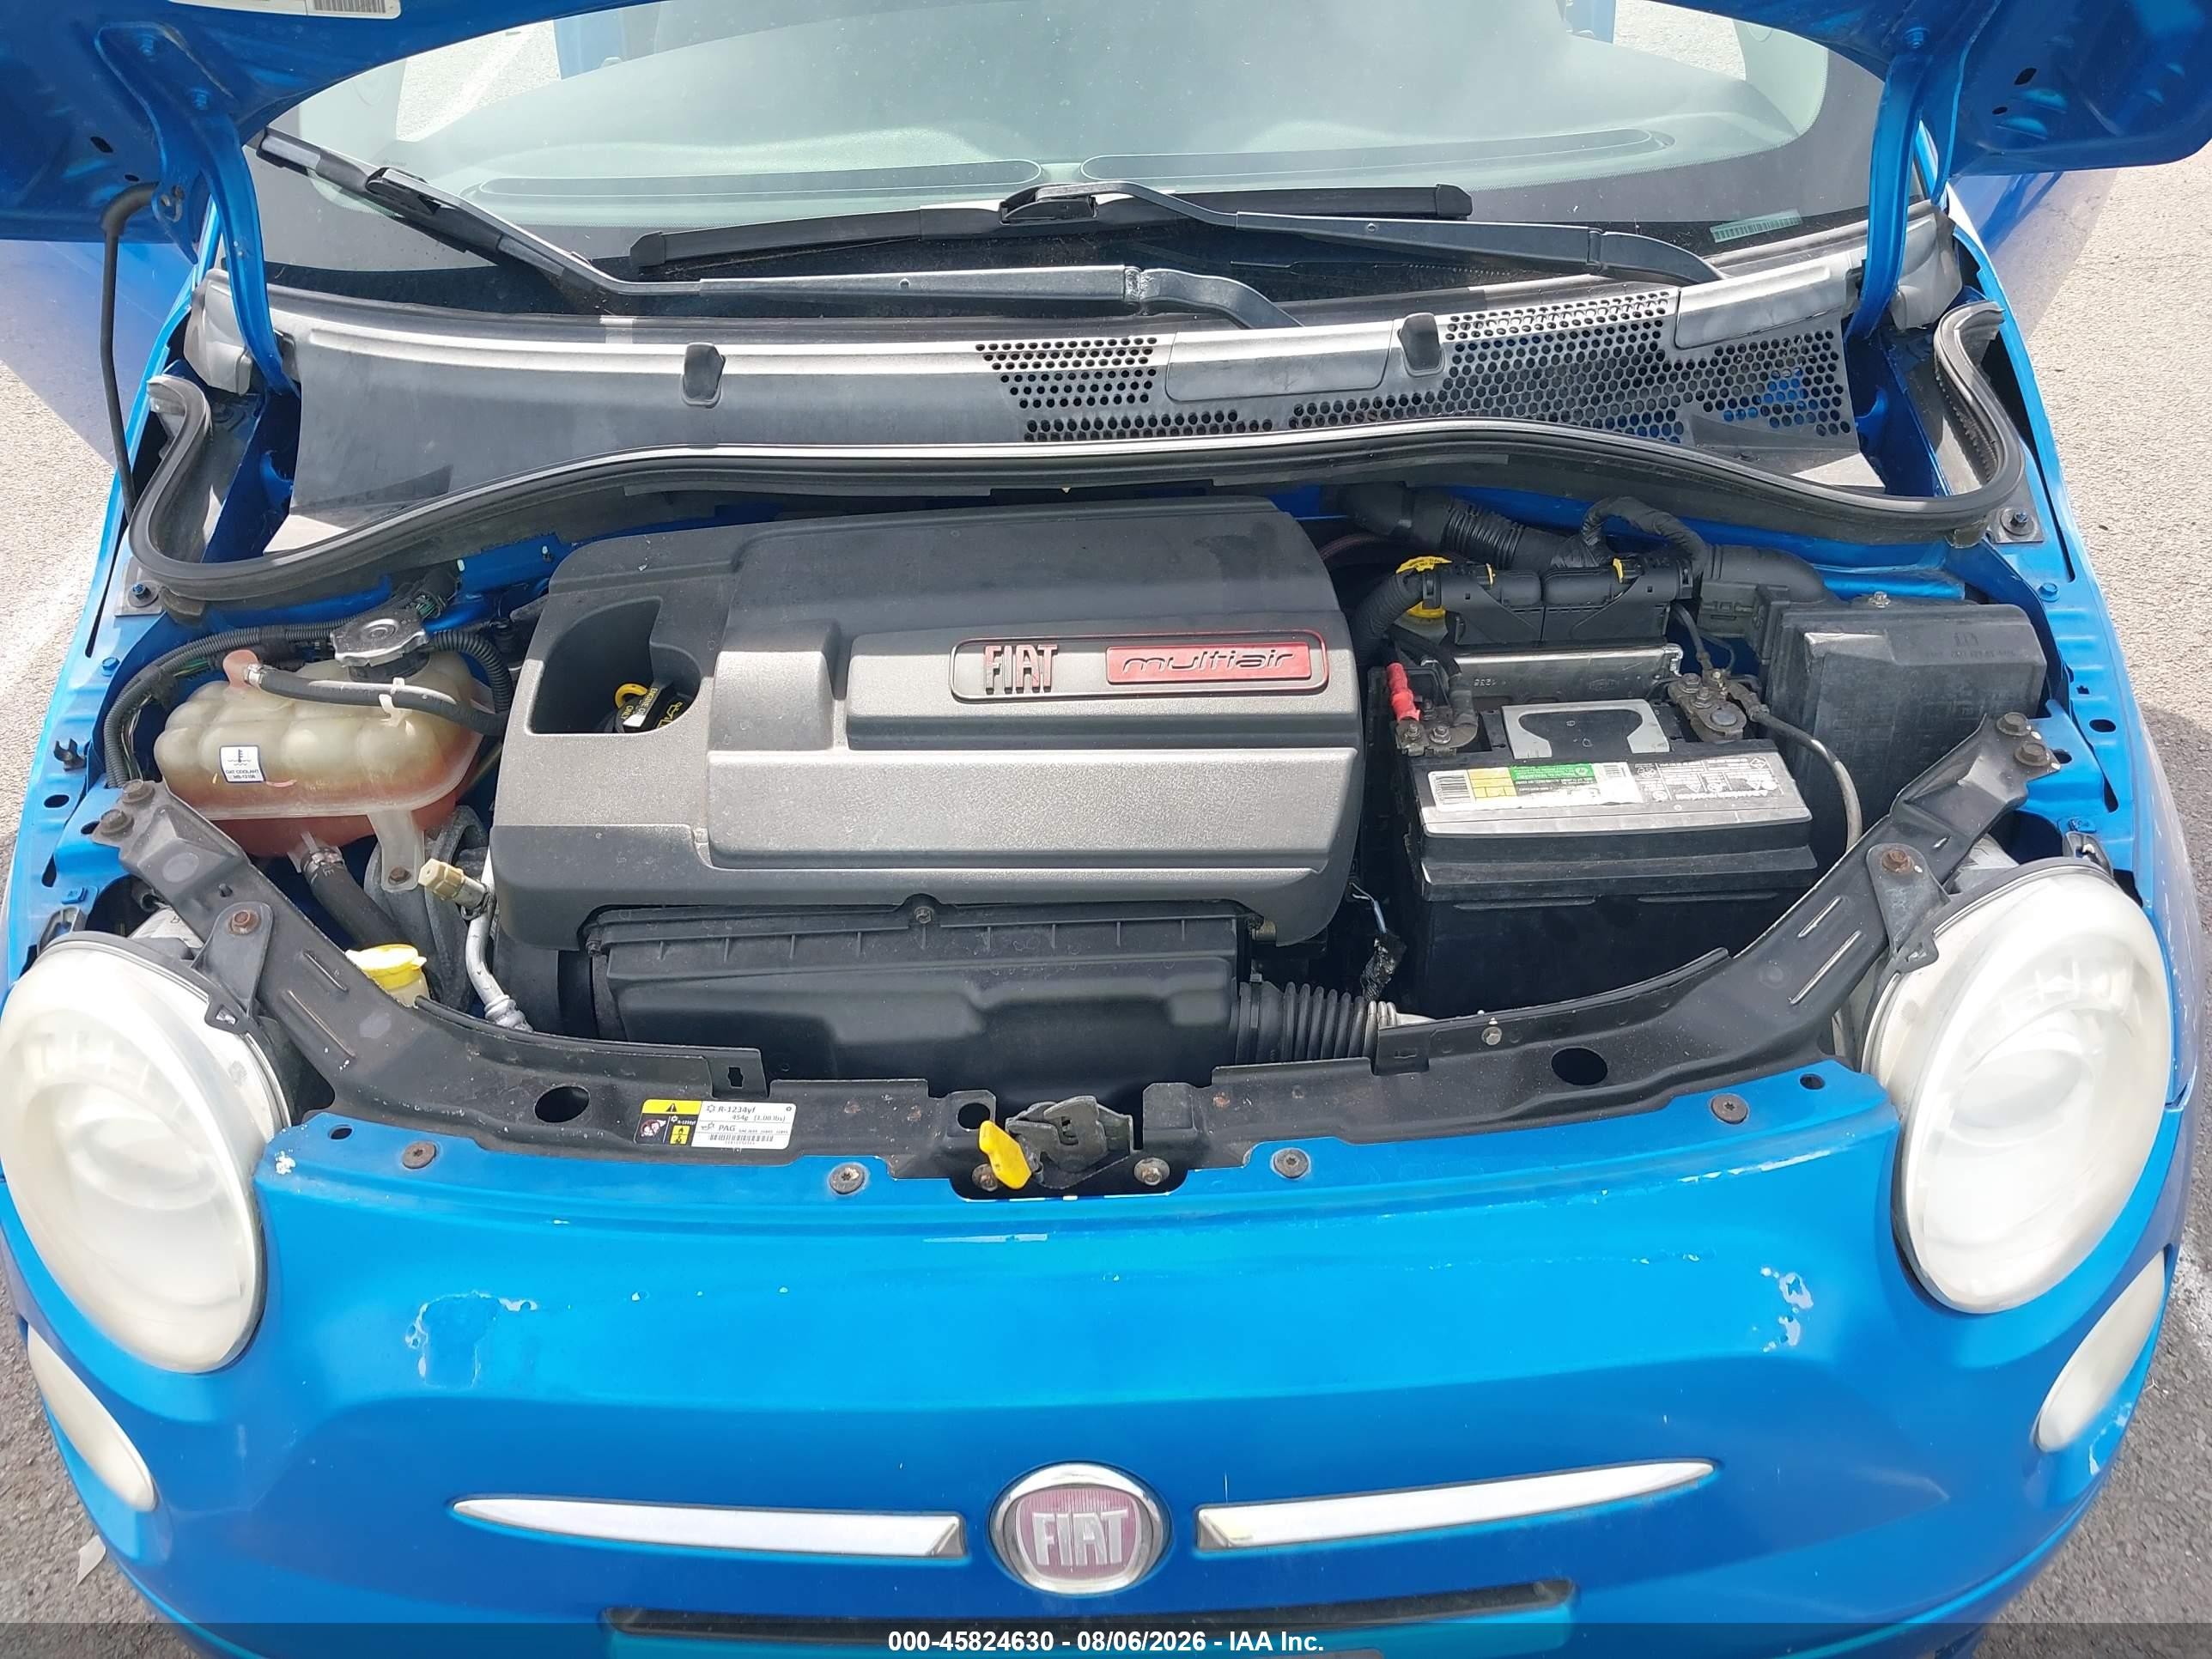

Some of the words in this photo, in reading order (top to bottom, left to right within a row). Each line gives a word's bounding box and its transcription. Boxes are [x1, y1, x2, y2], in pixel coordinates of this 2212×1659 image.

[983, 643, 1058, 694] FIAT
[1122, 649, 1296, 673] multiair
[641, 688, 659, 708] ENGINE
[621, 705, 634, 720] ONLY
[718, 1106, 756, 1115] R-1234yf
[1032, 1509, 1128, 1566] FIAT
